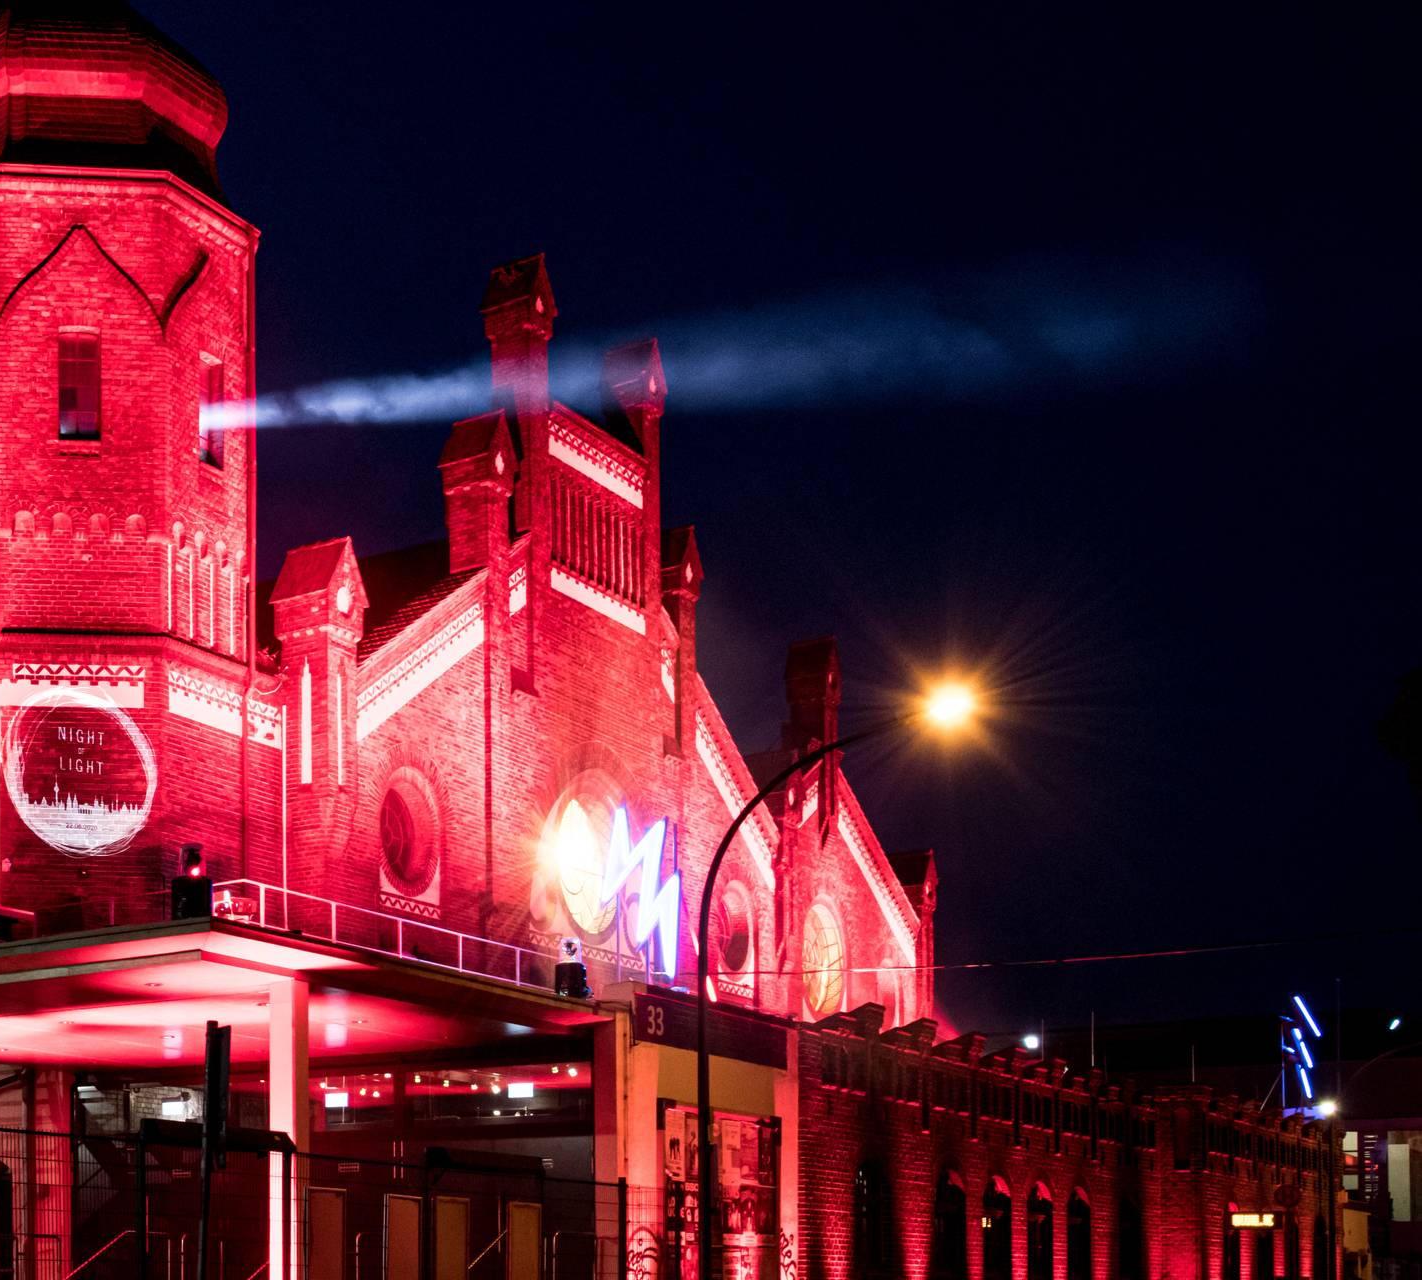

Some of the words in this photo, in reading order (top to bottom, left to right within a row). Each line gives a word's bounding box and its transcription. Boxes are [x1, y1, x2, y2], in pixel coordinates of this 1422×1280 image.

[58, 727, 105, 746] NIGHT
[59, 757, 104, 775] LIGHT
[647, 1005, 664, 1036] 33
